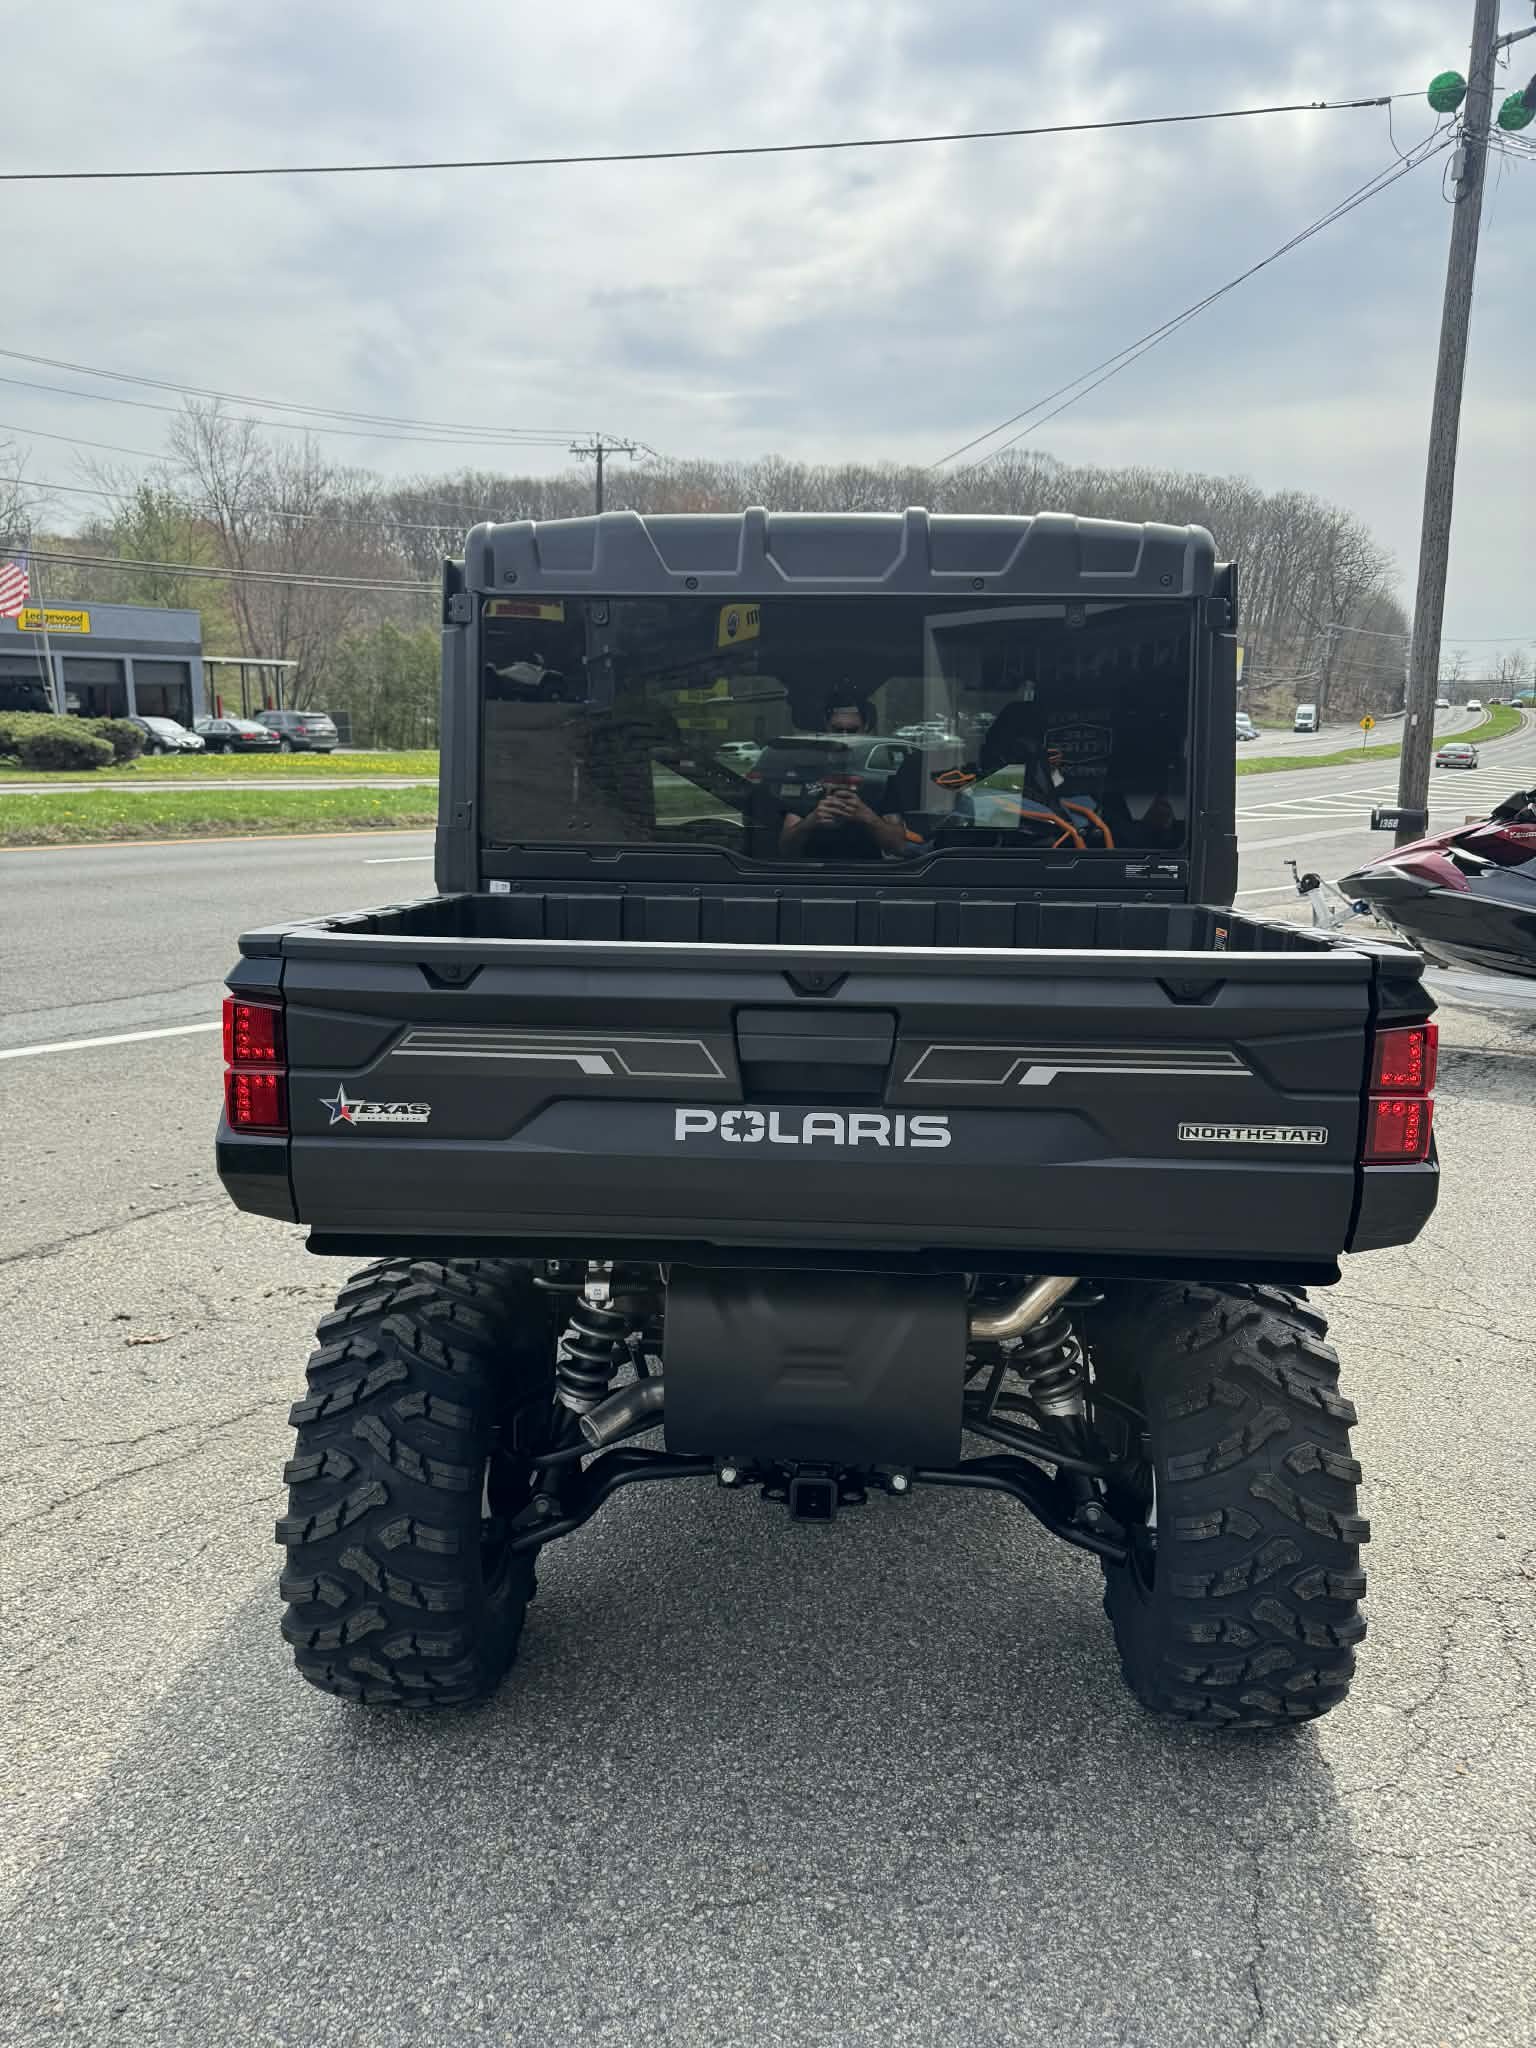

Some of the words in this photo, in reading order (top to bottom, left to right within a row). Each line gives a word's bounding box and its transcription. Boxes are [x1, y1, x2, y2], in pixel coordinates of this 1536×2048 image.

[347, 1102, 430, 1115] TEXAS
[674, 1108, 952, 1148] POLARIS
[1184, 1126, 1322, 1142] NORTHSTAR
